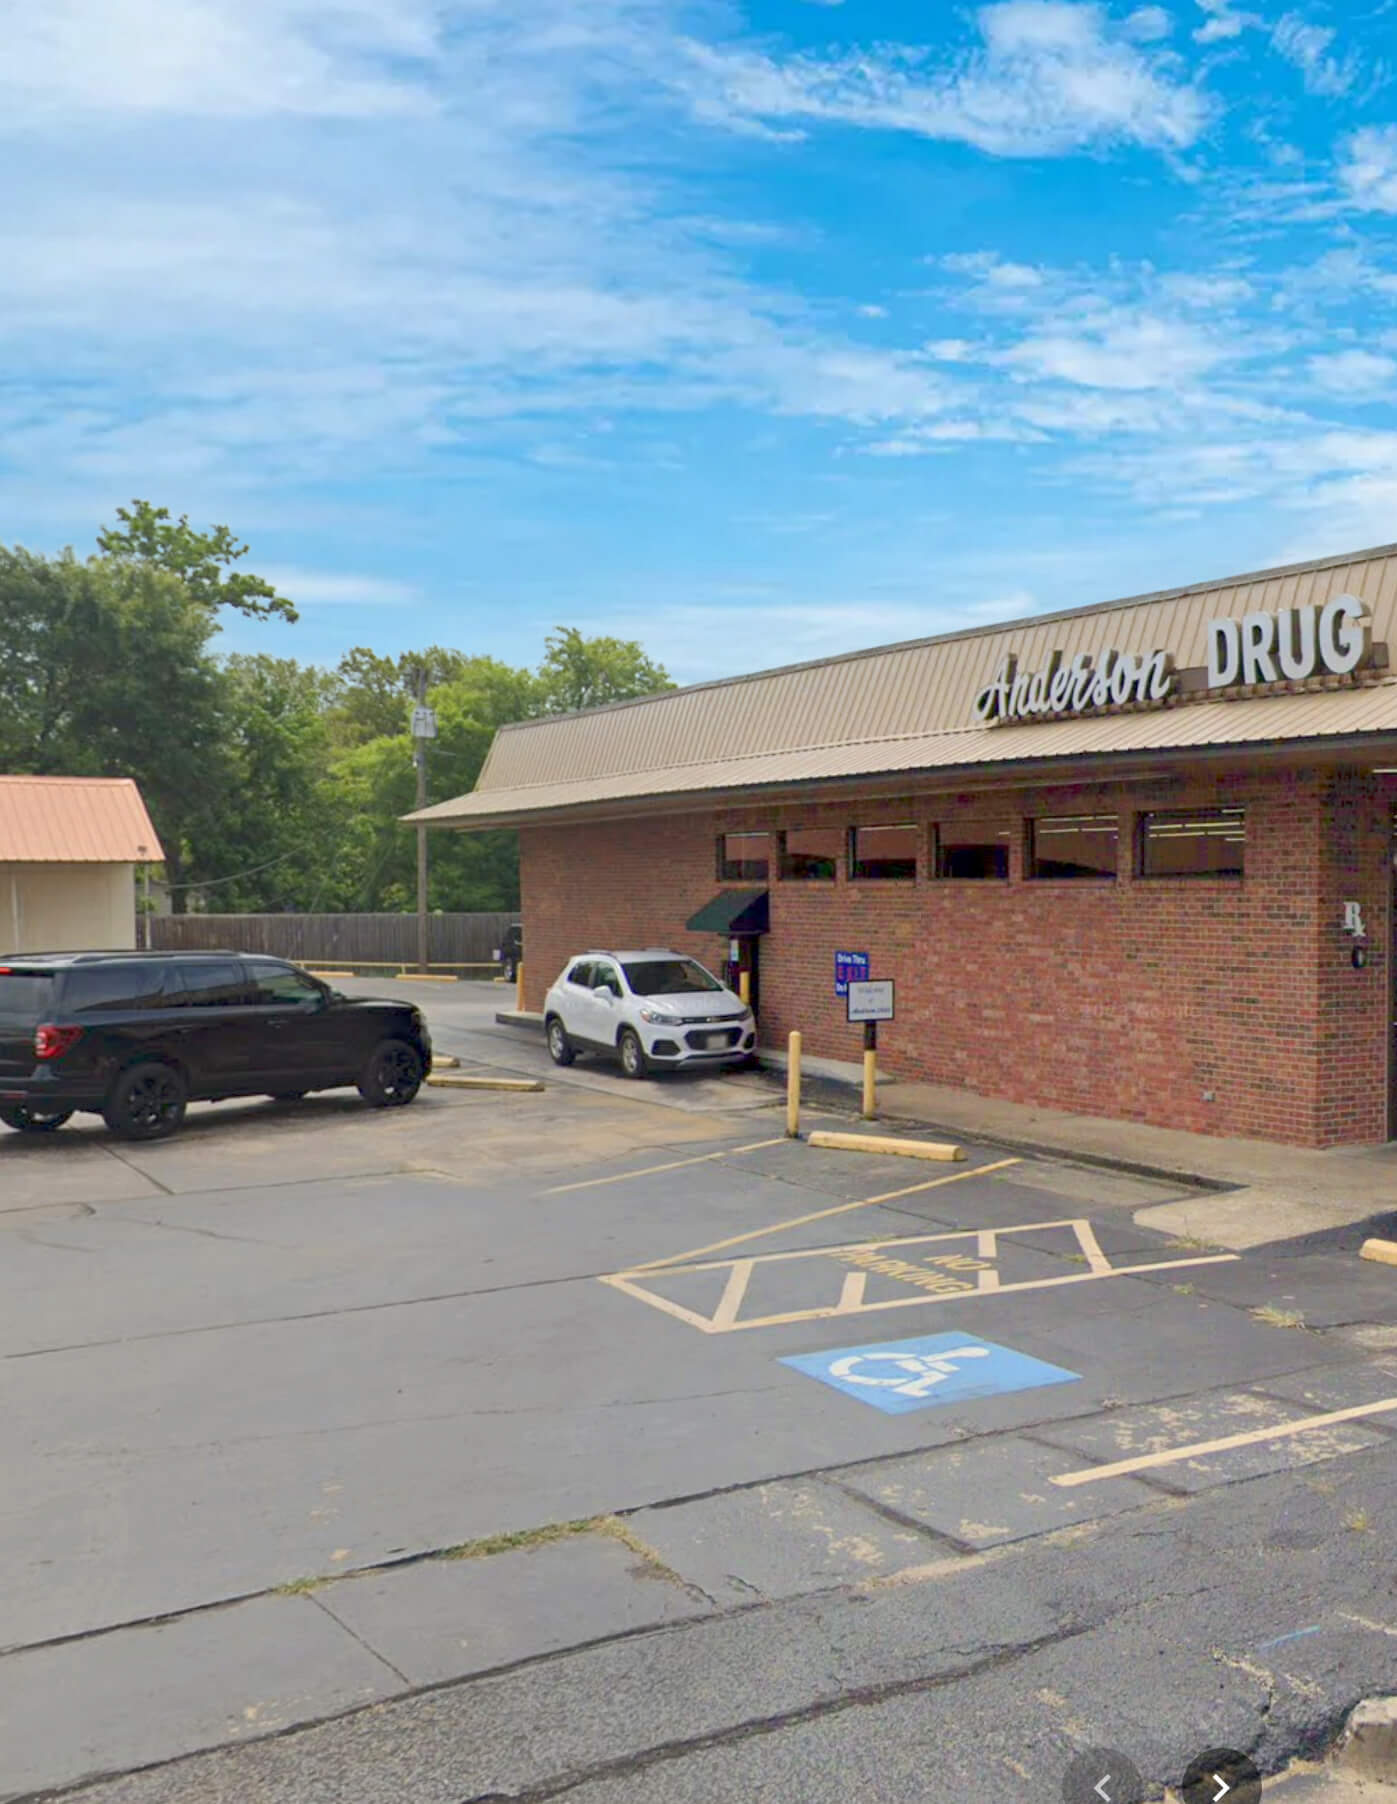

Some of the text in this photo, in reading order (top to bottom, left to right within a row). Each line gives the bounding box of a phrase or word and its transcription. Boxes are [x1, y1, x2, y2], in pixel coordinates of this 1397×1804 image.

[973, 593, 1372, 721] Anderson DRUG
[829, 1247, 975, 1294] PARKING
[923, 1253, 992, 1271] NO
